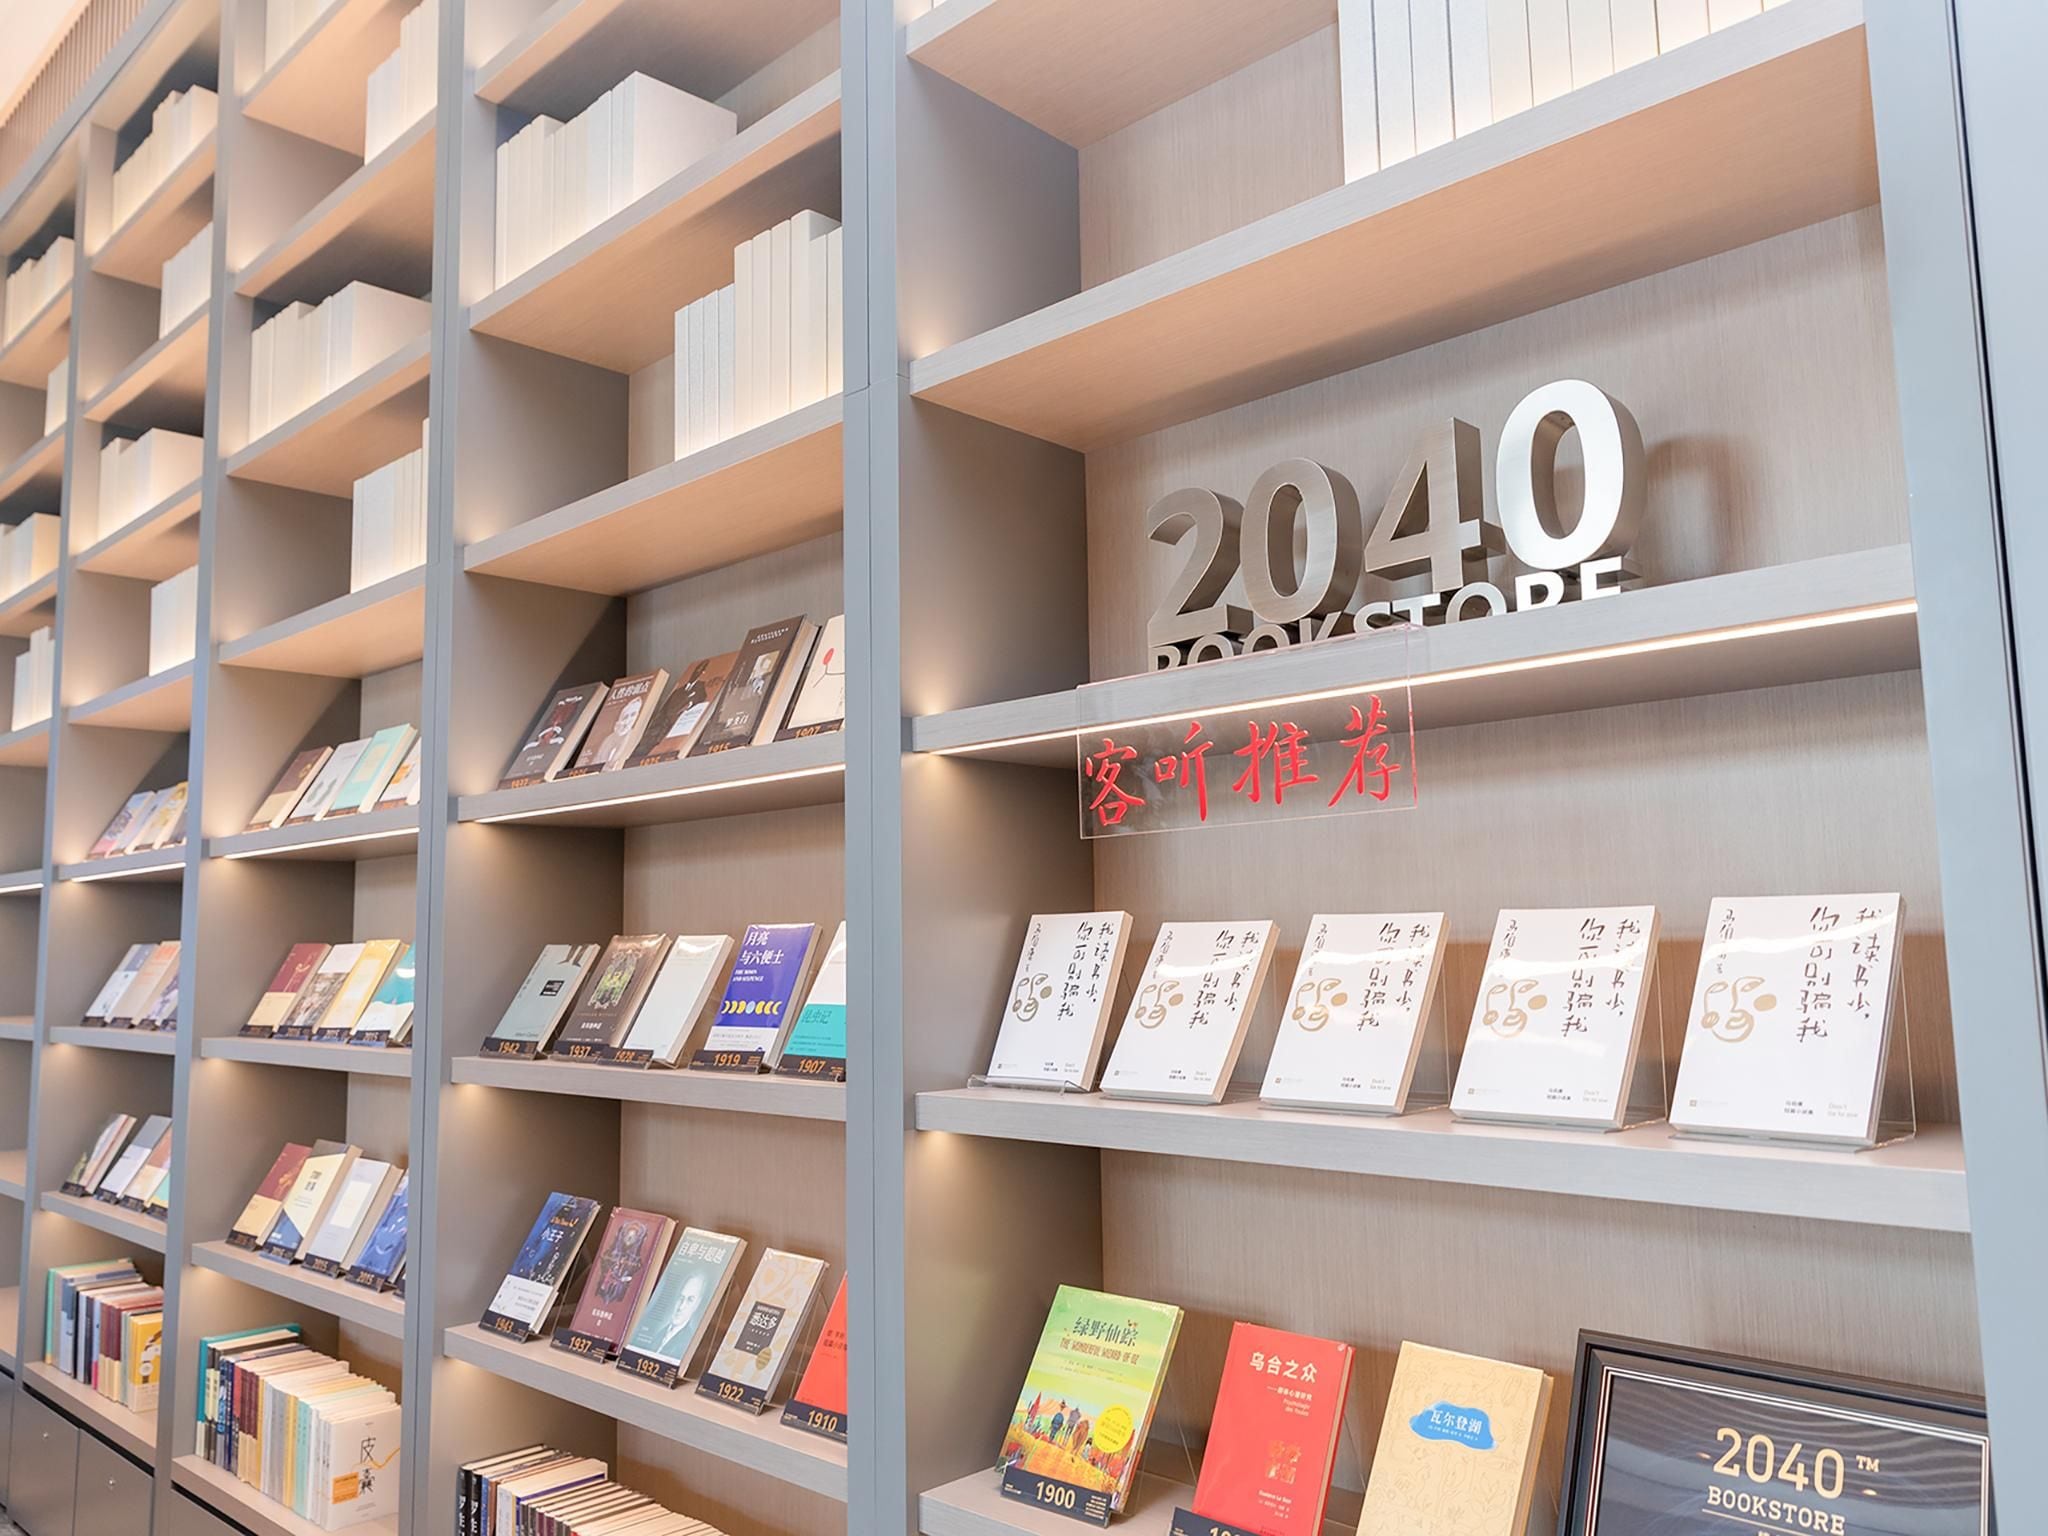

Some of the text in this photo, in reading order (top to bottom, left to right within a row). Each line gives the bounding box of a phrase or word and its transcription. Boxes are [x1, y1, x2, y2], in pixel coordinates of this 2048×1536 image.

[1147, 379, 1640, 647] 2040
[1085, 694, 1401, 827] 客听推荐
[746, 930, 770, 946] 月亮
[740, 950, 785, 965] 与六便士
[569, 1045, 592, 1057] 1937
[714, 1053, 741, 1067] 1919
[798, 1059, 825, 1073] 1907
[1073, 1317, 1138, 1347] 绿野仙踪
[569, 1336, 592, 1354] 1937
[636, 1358, 660, 1378] 1932
[1249, 1351, 1318, 1383] 乌合之众
[717, 1382, 744, 1402] 1922
[807, 1410, 838, 1433] 1910
[1430, 1410, 1483, 1435] 瓦尔登湖
[1712, 1427, 1844, 1499] 2040
[1036, 1481, 1076, 1509] 1900
[1707, 1485, 1846, 1536] BOOKSTORE
